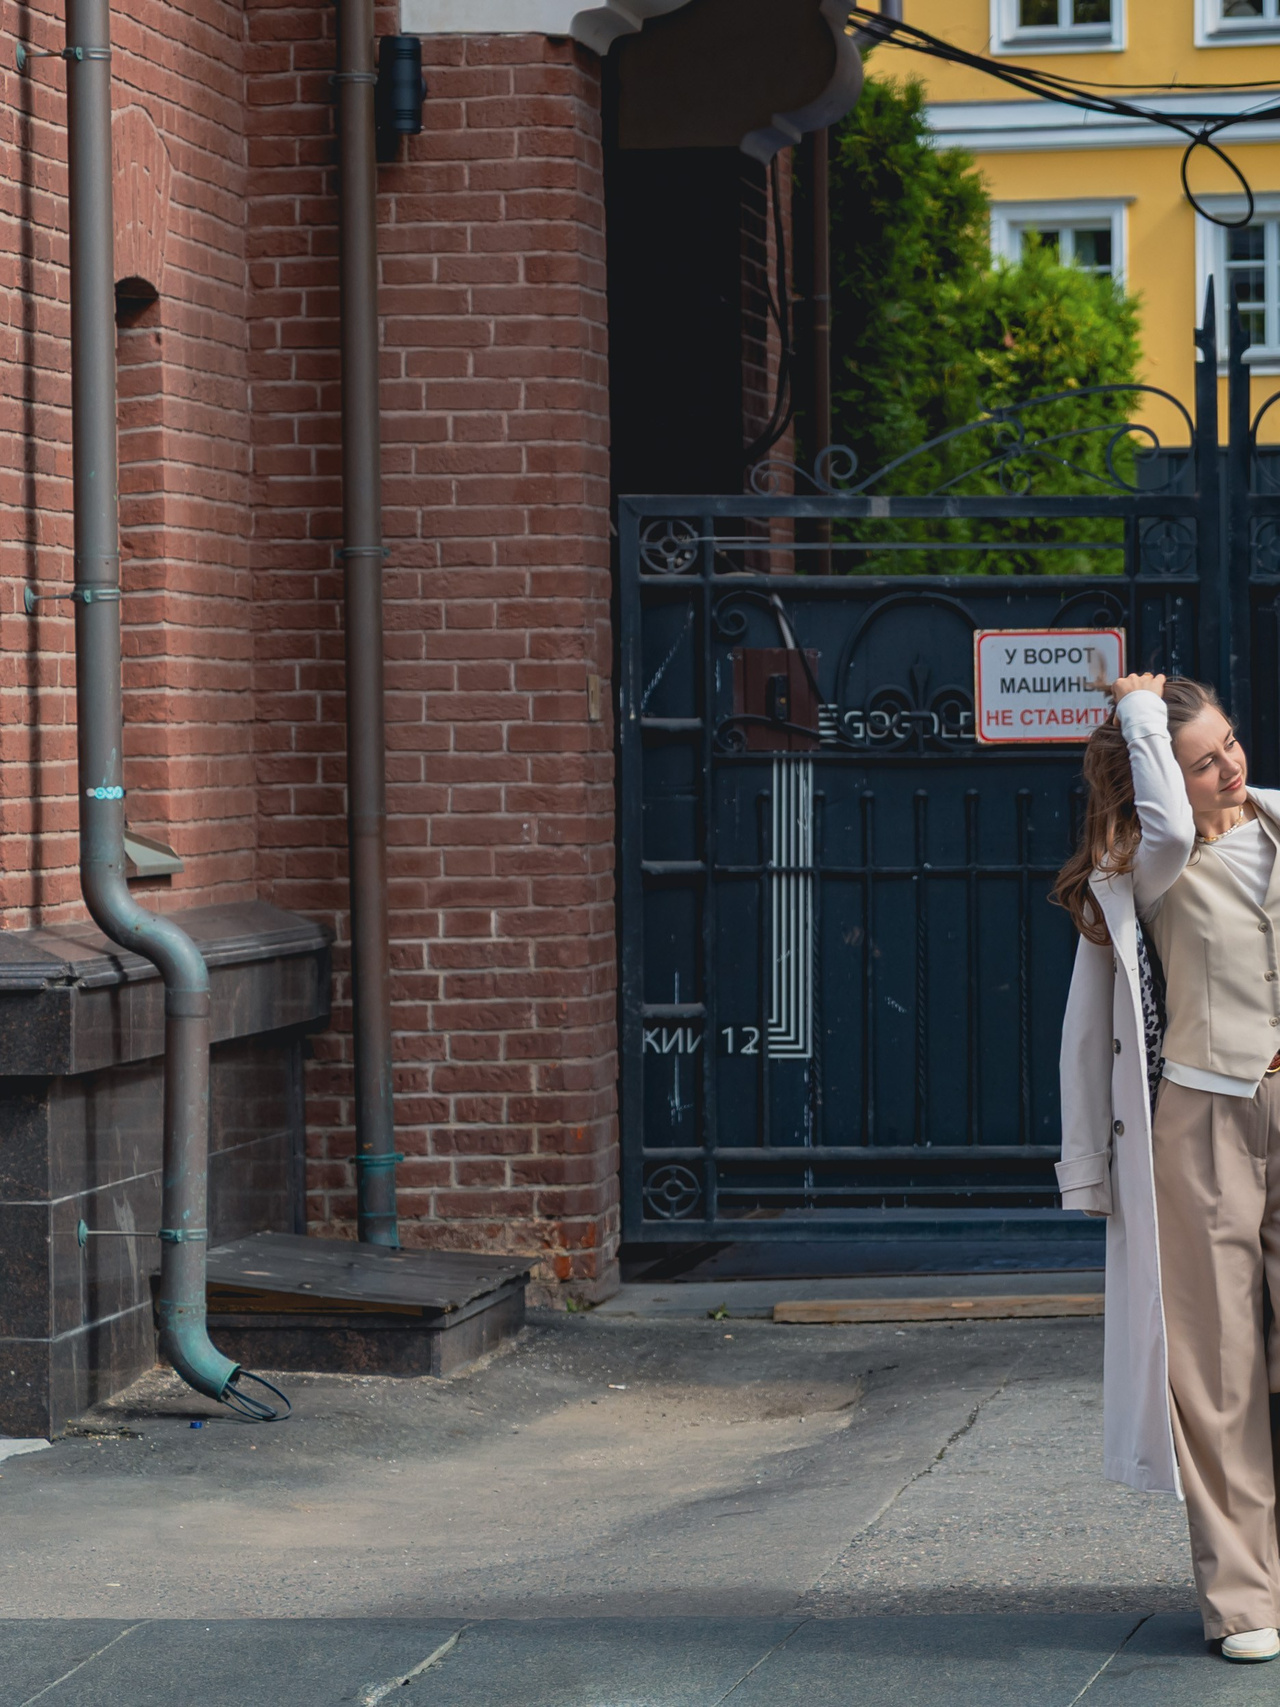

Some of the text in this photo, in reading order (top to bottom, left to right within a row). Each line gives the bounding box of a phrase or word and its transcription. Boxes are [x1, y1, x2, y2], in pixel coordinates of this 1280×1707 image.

[1004, 647, 1096, 665] У ВОРОТ
[986, 709, 1013, 726] НЕ
[721, 1026, 760, 1054] 12
